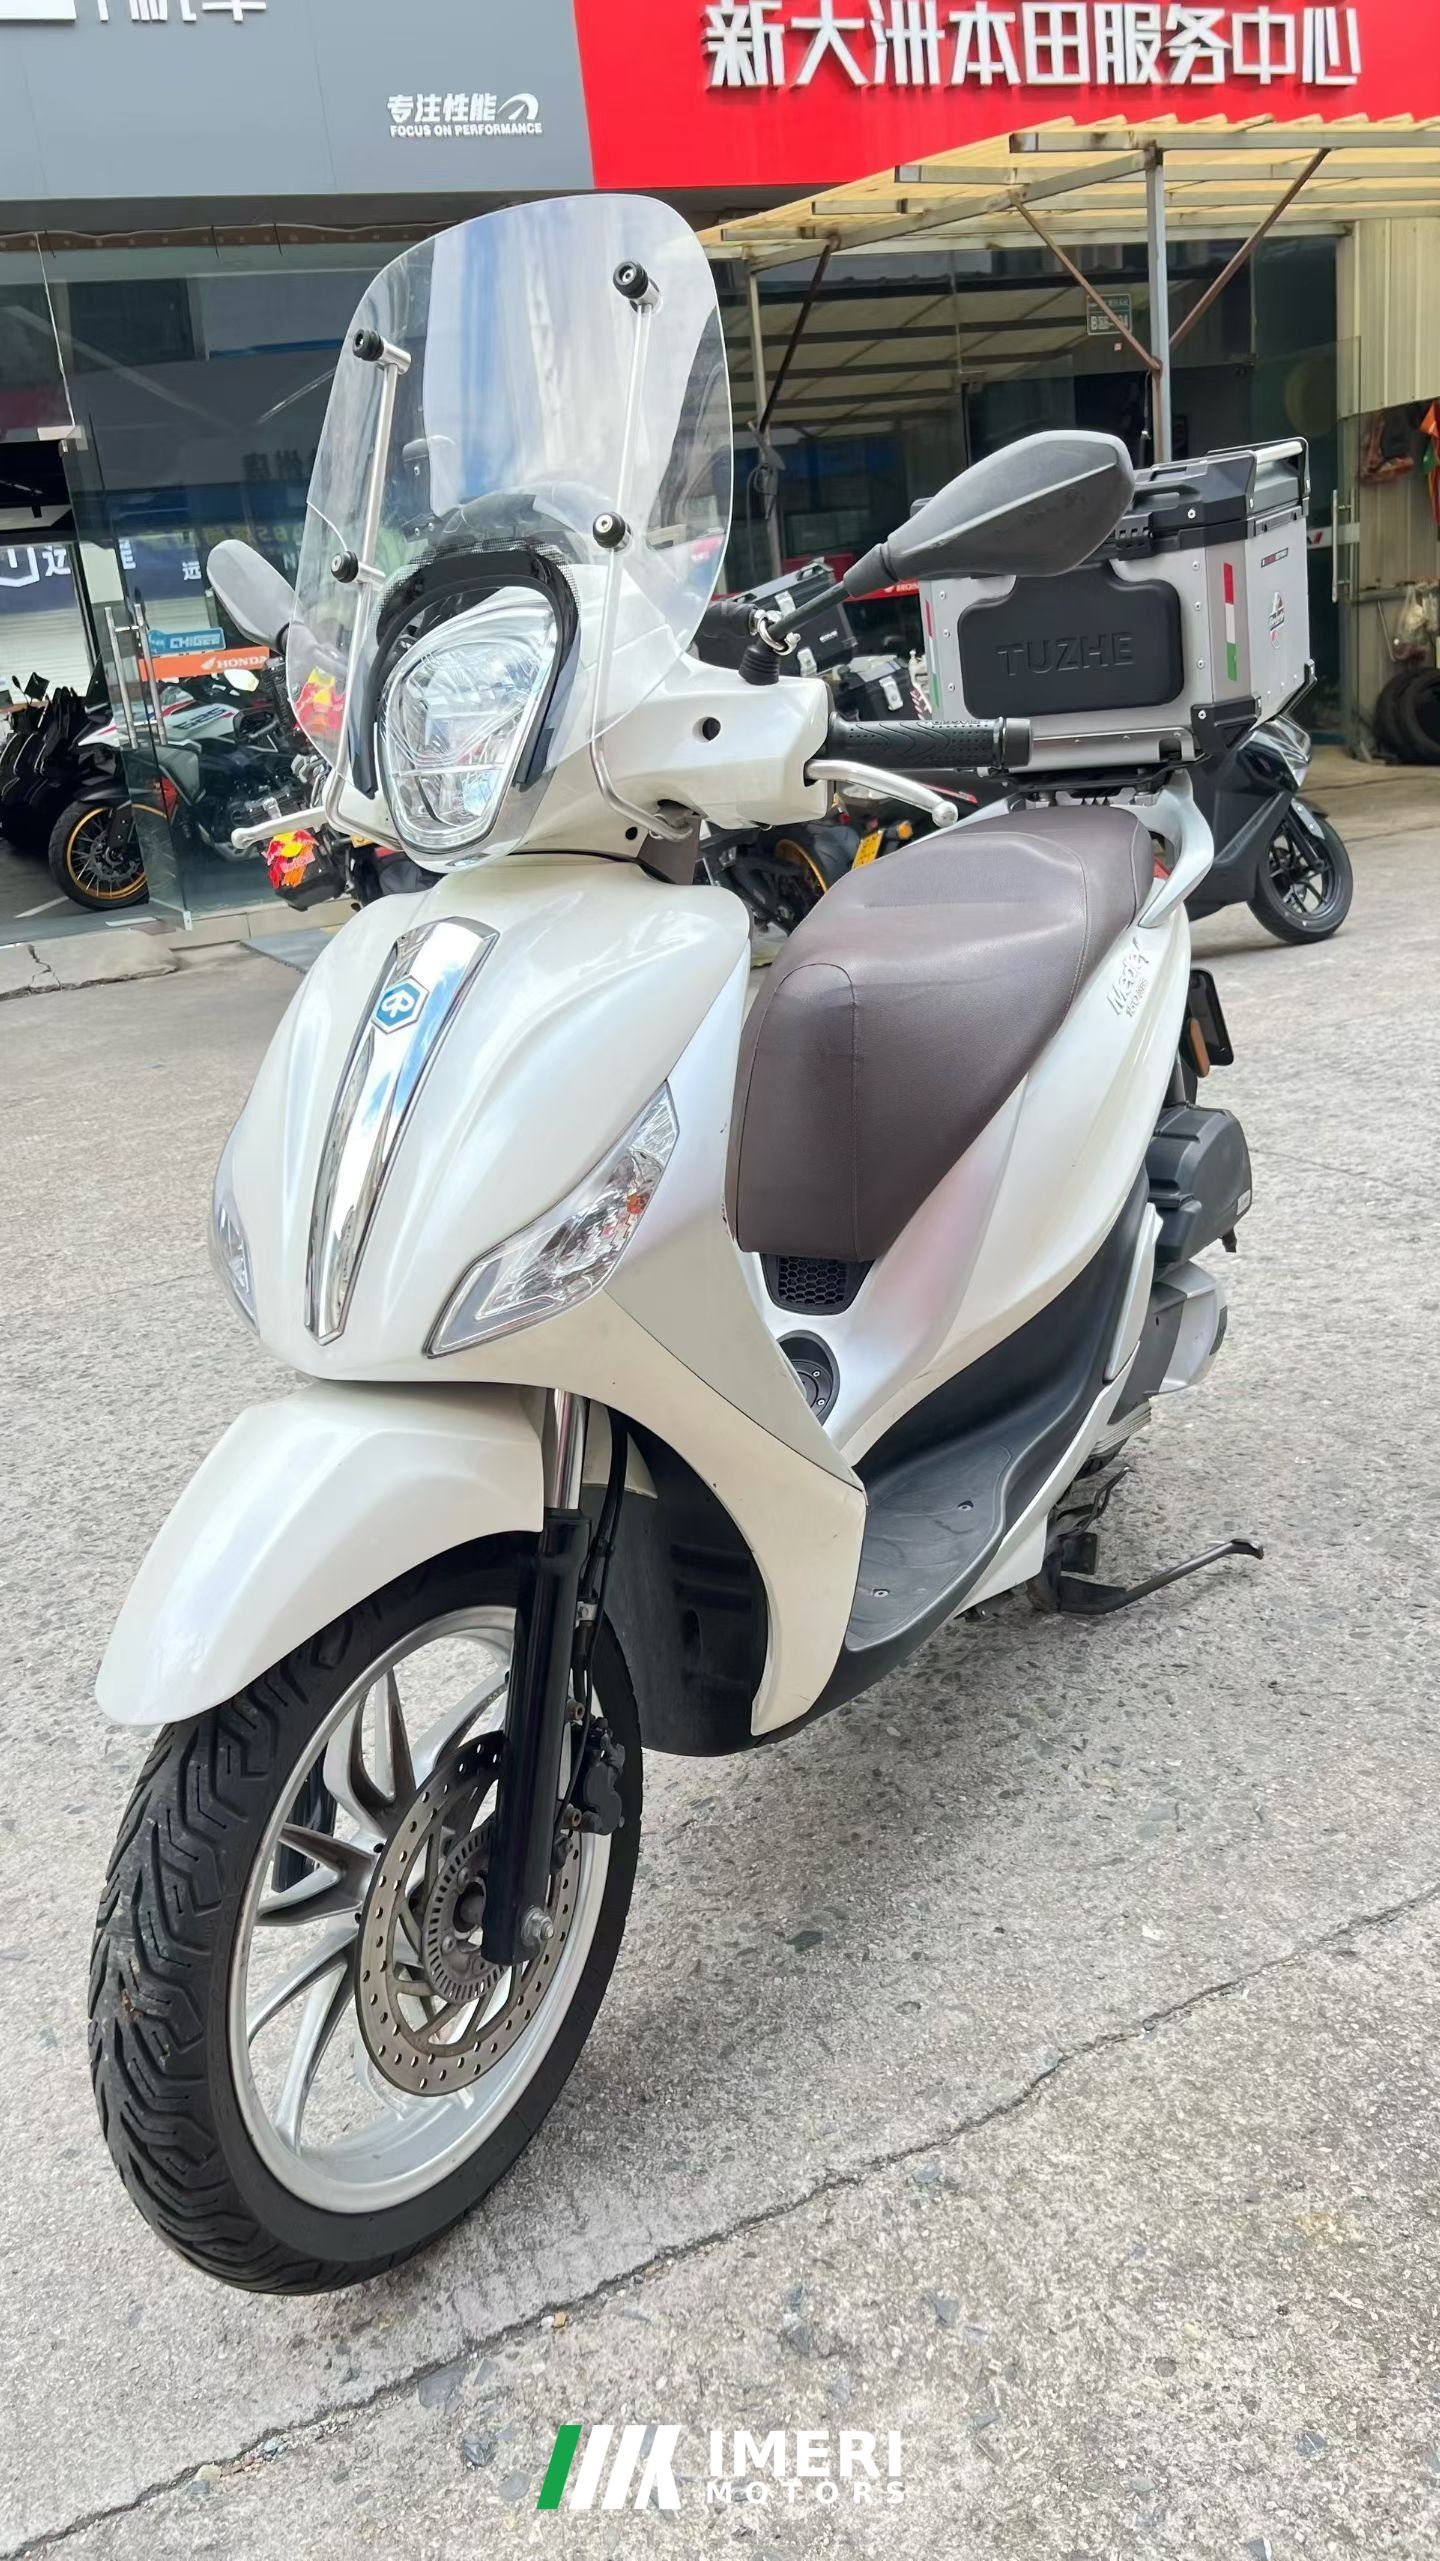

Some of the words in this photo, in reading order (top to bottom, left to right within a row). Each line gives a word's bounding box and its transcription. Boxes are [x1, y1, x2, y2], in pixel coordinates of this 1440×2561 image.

[705, 0, 1362, 87] 新大洲本田服务中心
[387, 92, 497, 123] 专注性能
[390, 124, 431, 138] FOCUS
[434, 124, 452, 137] ON
[454, 122, 543, 137] PERFORMANCE
[996, 631, 1134, 676] TUZHE
